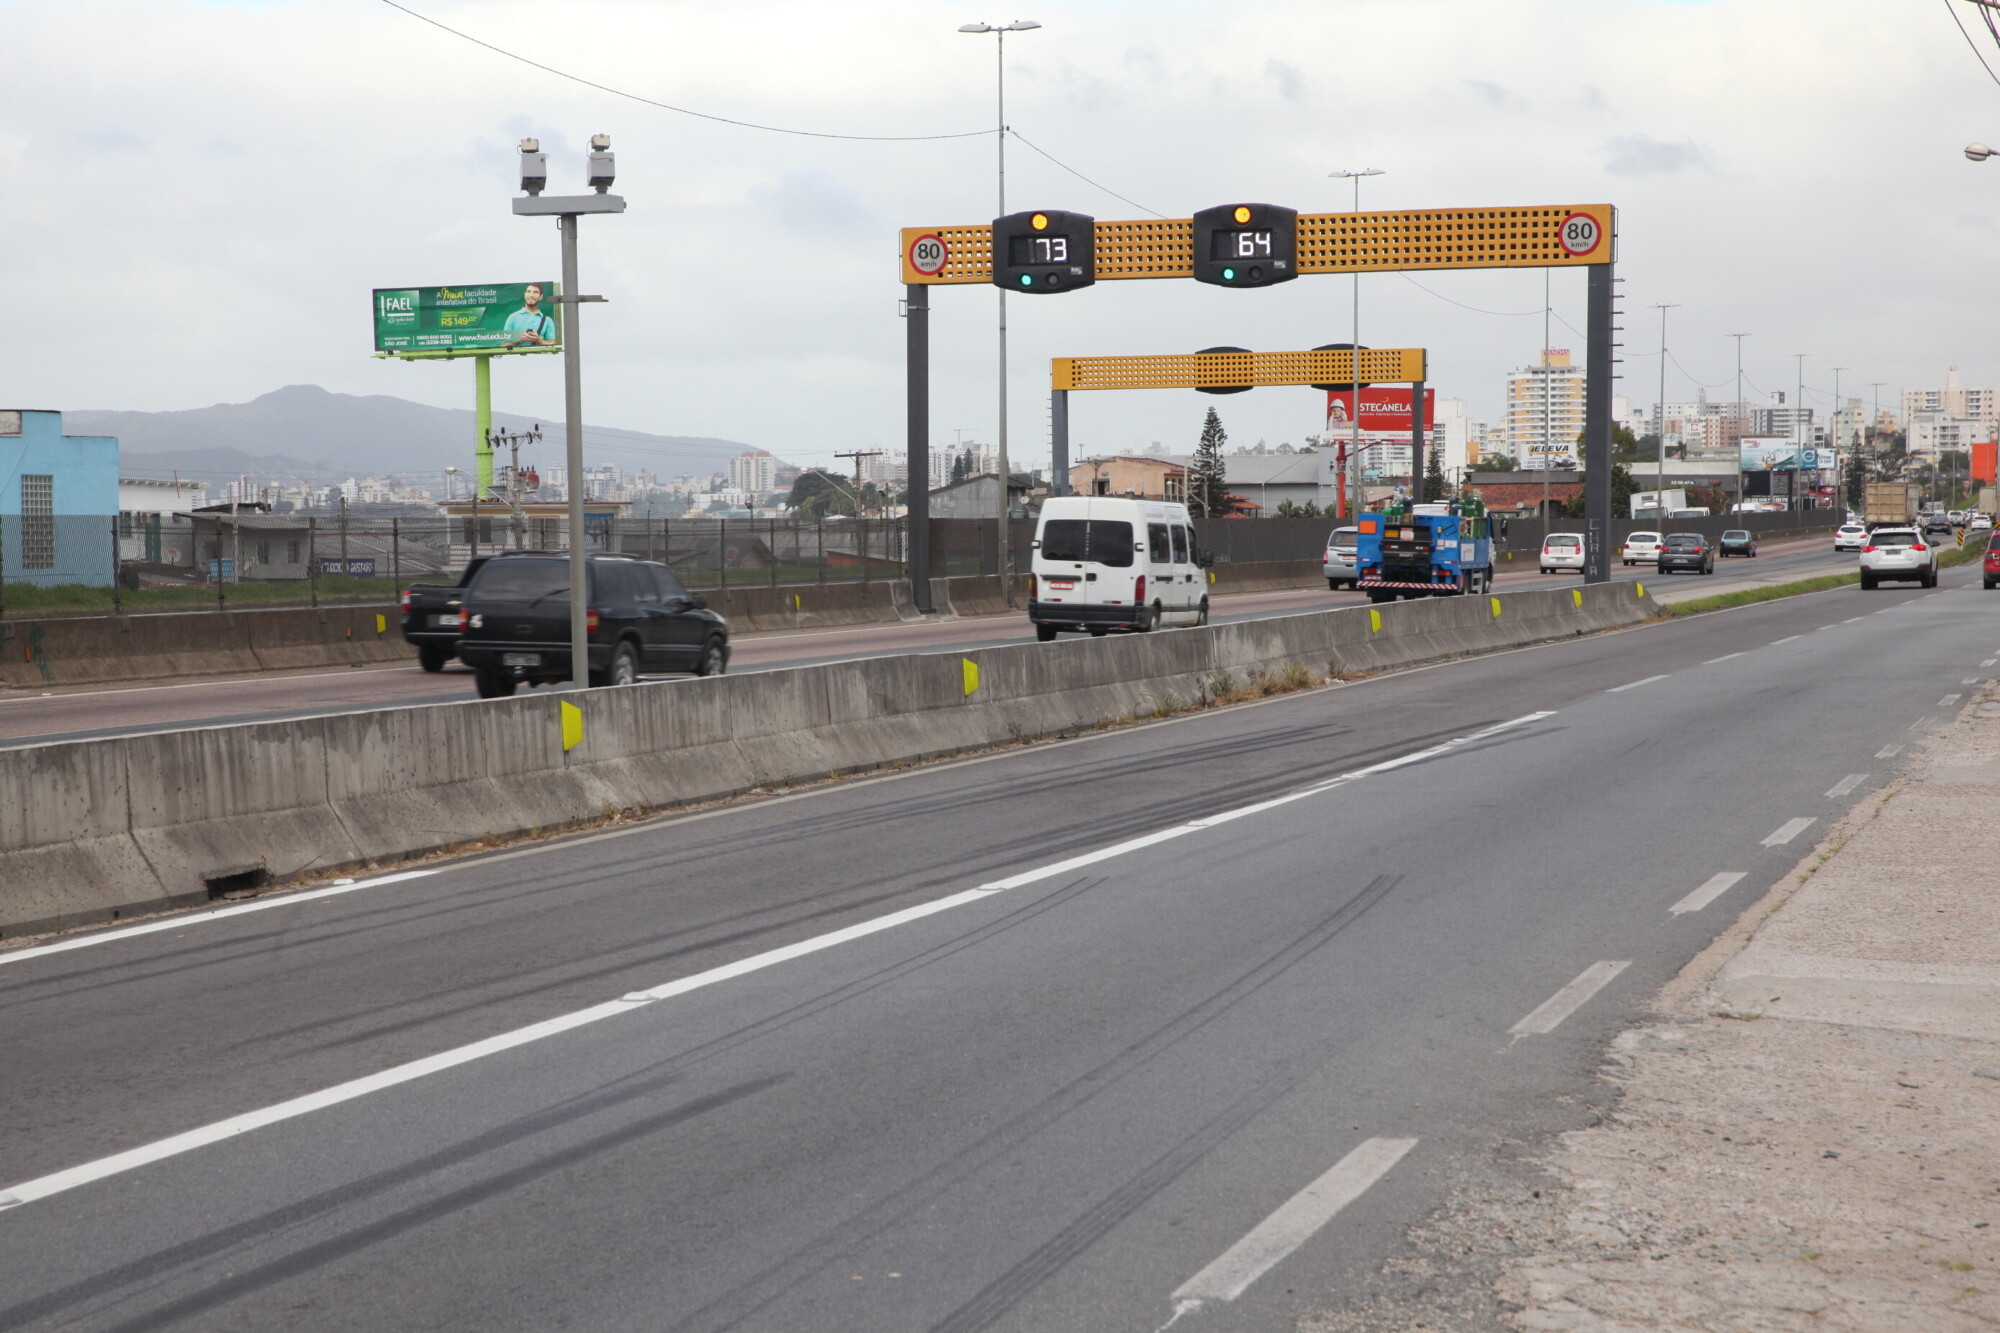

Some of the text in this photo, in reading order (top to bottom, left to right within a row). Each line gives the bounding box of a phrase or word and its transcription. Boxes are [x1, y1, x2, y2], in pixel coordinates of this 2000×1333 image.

[1567, 223, 1592, 240] 80
[1036, 238, 1067, 261] 73
[1239, 232, 1270, 256] 64
[918, 243, 940, 260] 80
[920, 260, 937, 268] km/h
[464, 289, 497, 297] faculdade
[387, 297, 412, 310] FAEL
[436, 296, 497, 306] interativa do Brasil
[459, 333, 512, 342] www.fael.edu.br
[1359, 403, 1412, 412] STECANELA
